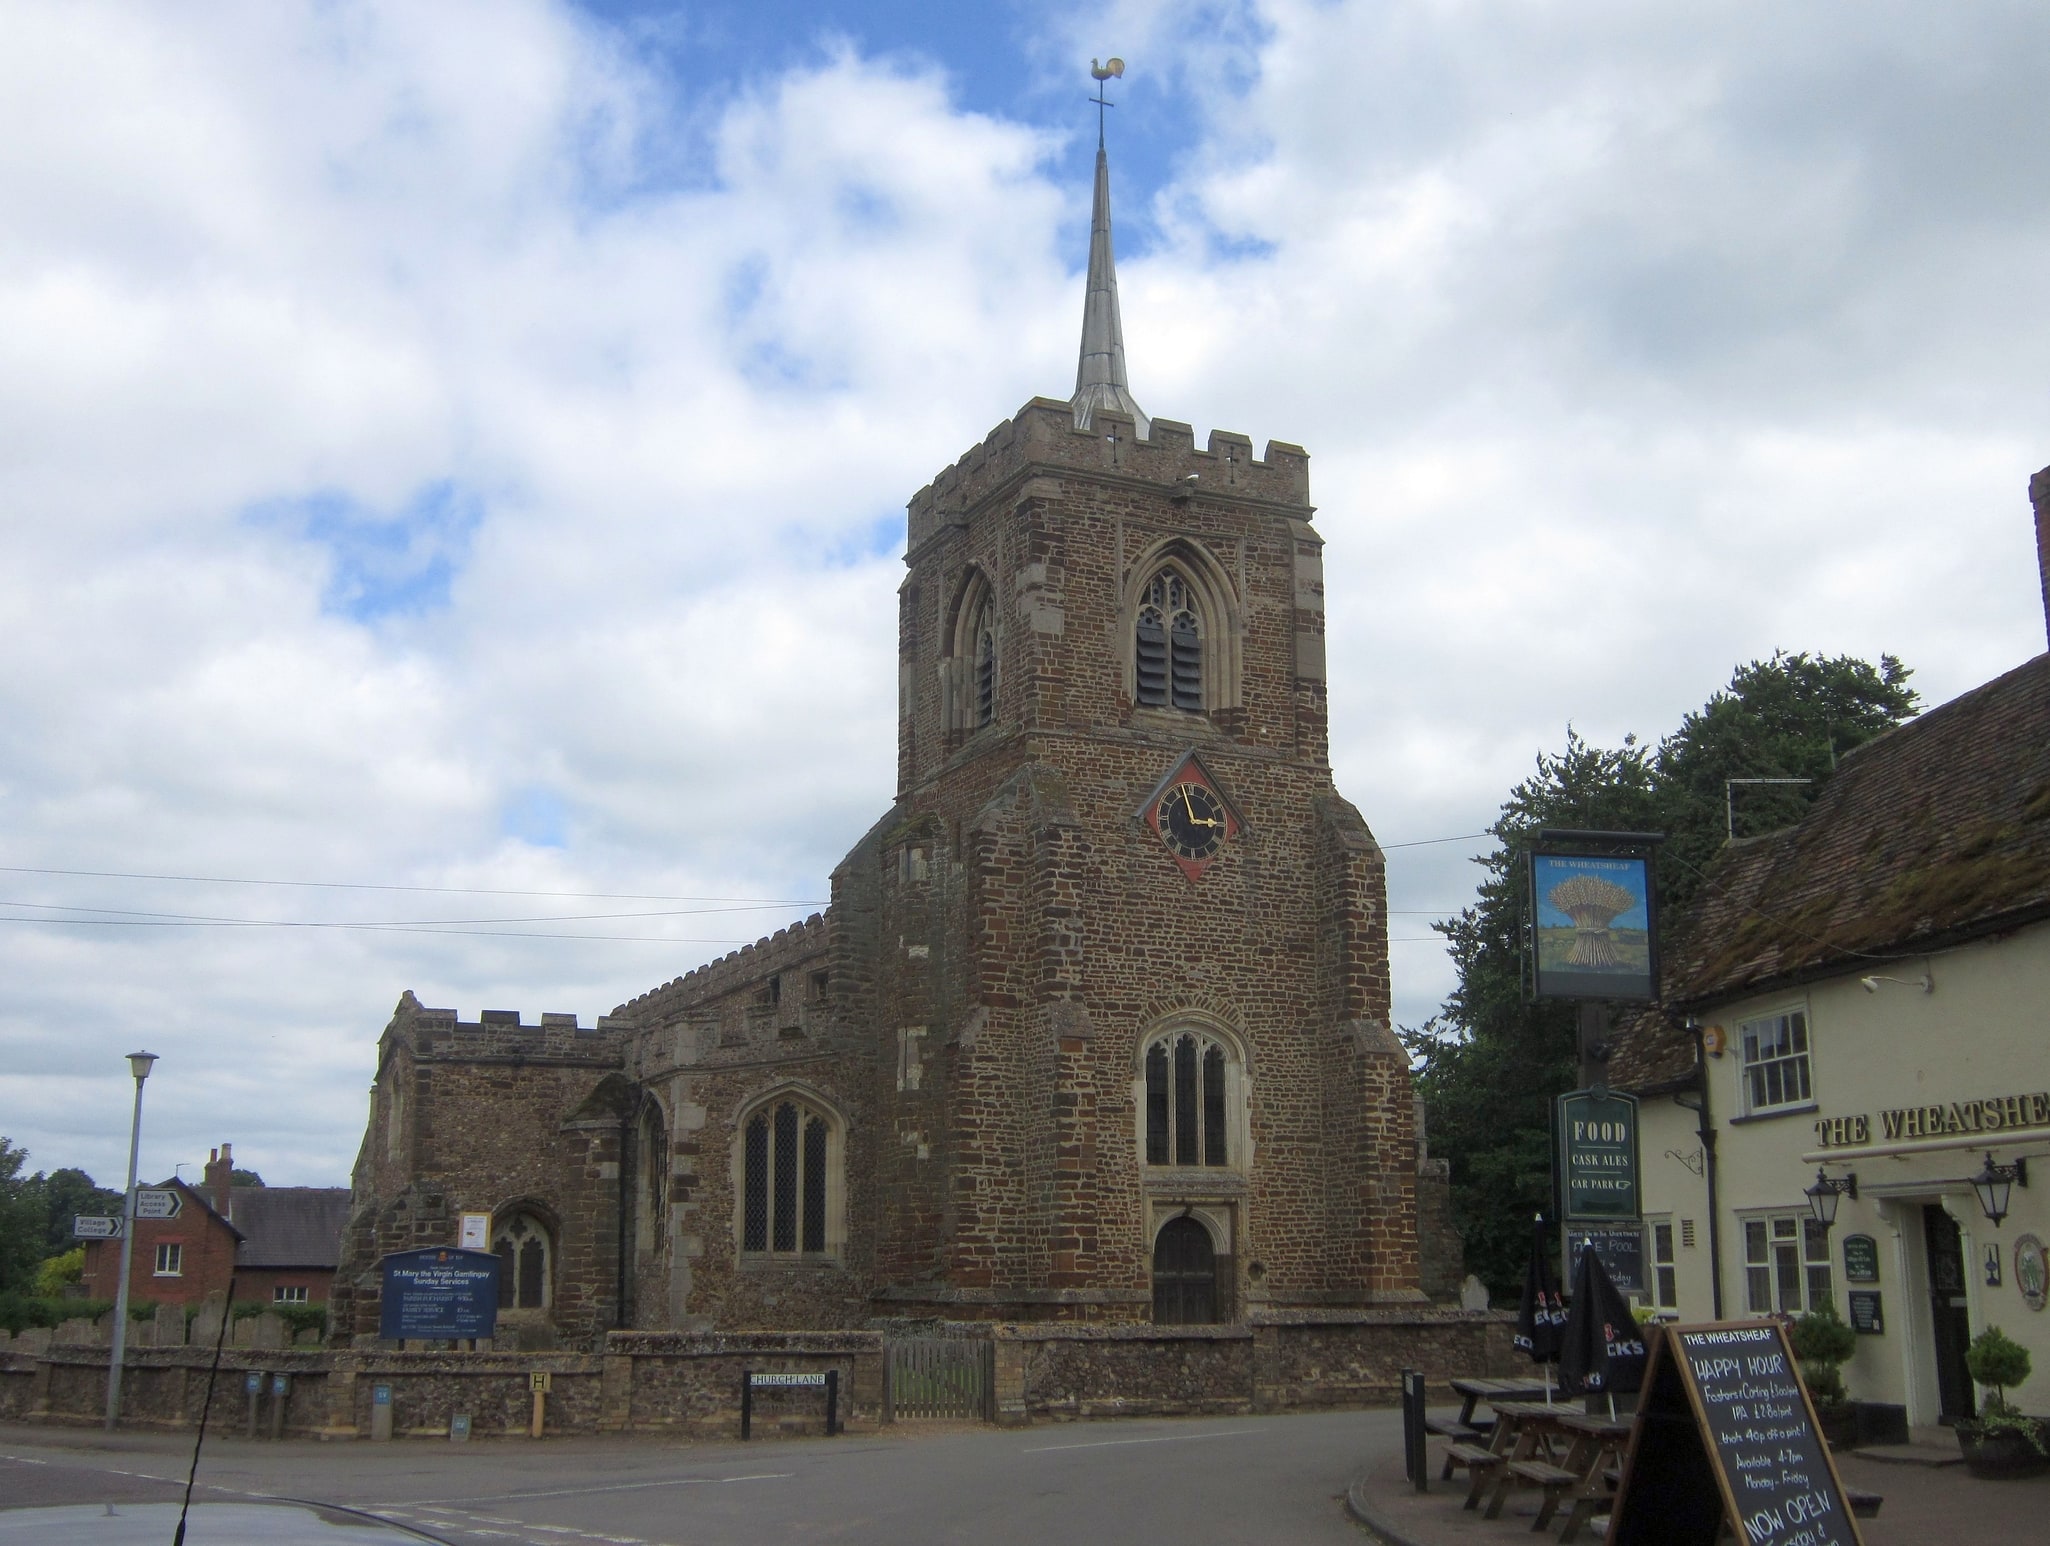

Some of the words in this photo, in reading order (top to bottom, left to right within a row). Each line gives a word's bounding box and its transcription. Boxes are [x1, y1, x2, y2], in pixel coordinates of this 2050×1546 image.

[1549, 859, 1567, 868] THE
[1568, 861, 1631, 871] WHEATSHEAF
[1814, 1114, 1868, 1147] THE
[1878, 1091, 2050, 1140] WHEATSHE
[1574, 1121, 1626, 1142] FOOD
[1572, 1153, 1599, 1166] CASK
[1602, 1155, 1629, 1167] ALES
[1571, 1179, 1588, 1190] CAR
[1591, 1180, 1614, 1190] PARK
[77, 1226, 107, 1234] College
[1608, 1240, 1639, 1253] POOL
[402, 1270, 419, 1278] Mary
[433, 1270, 453, 1278] Virgin
[454, 1270, 490, 1279] Gamlingay
[413, 1278, 439, 1286] Sunday
[1683, 1334, 1706, 1346] THE
[1705, 1329, 1772, 1345] WHEATSHEAF
[533, 1374, 545, 1389] H
[751, 1375, 793, 1385] CHURCH
[796, 1375, 824, 1384] LANE
[1732, 1404, 1749, 1421] IPA
[1745, 1428, 1765, 1445] 40p
[1735, 1452, 1773, 1470] Available
[1781, 1470, 1810, 1490] Friday
[1743, 1507, 1785, 1544] NOW
[1785, 1490, 1832, 1524] OPEN
